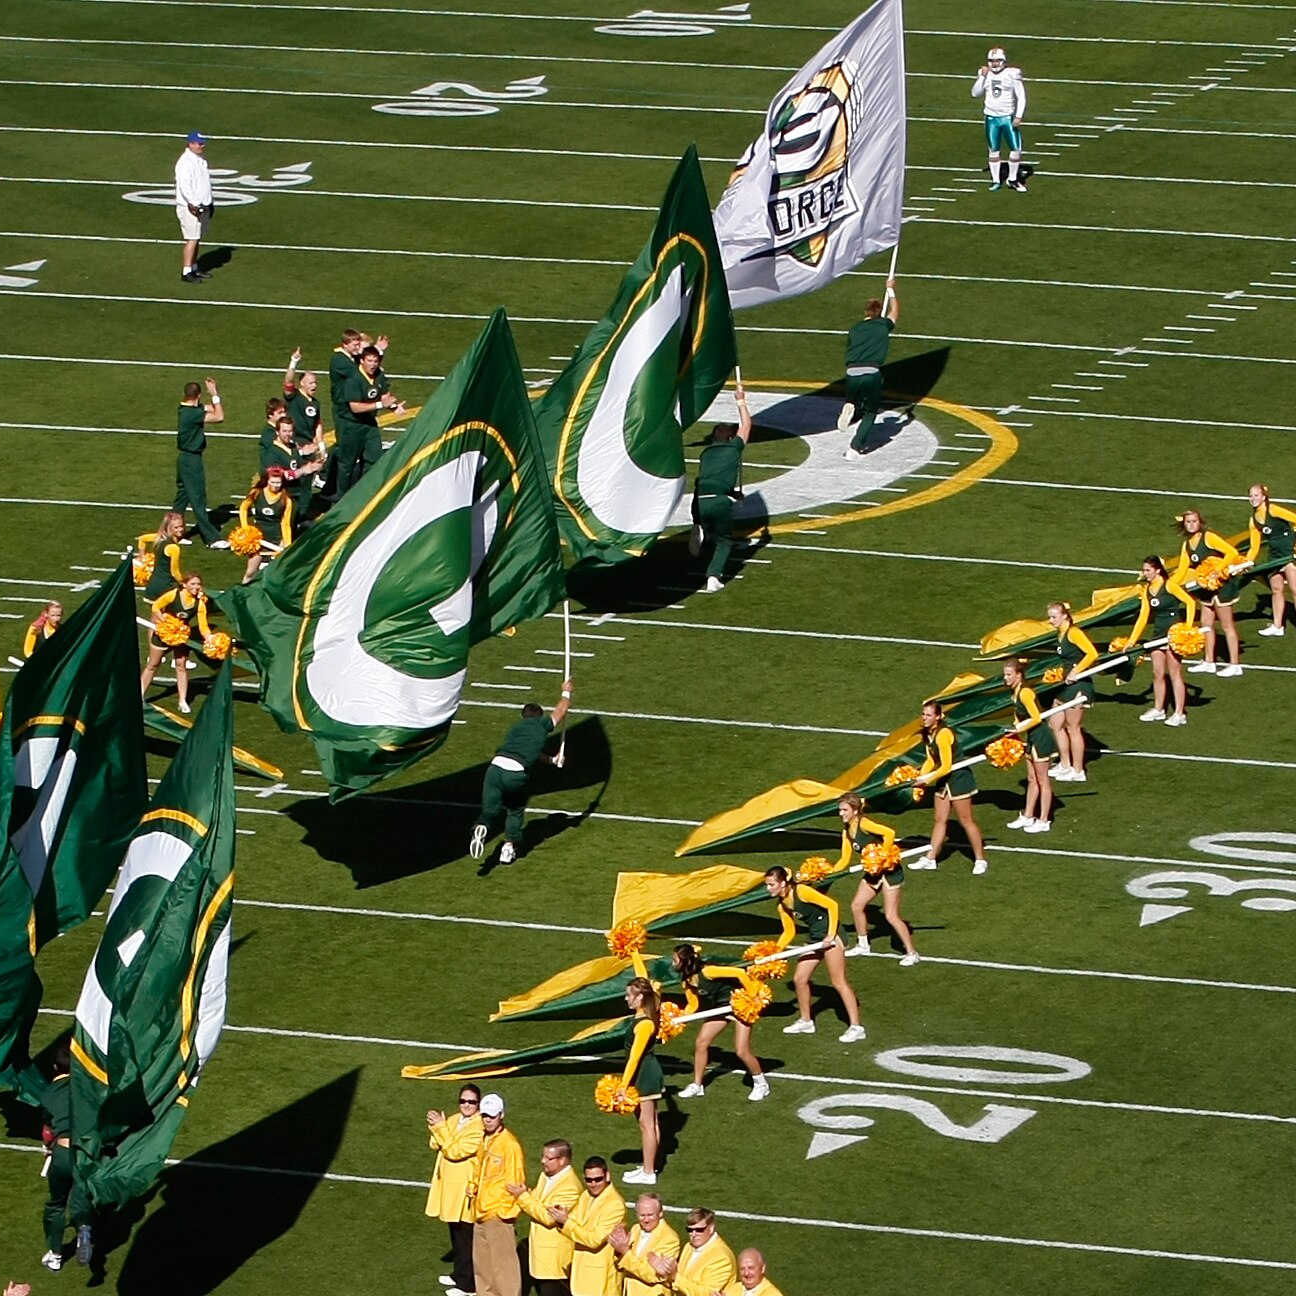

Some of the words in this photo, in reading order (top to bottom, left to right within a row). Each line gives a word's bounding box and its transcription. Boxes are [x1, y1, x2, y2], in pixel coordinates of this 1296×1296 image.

[372, 81, 548, 116] 20
[769, 179, 849, 237] ORCE
[796, 1044, 1093, 1143] 20
